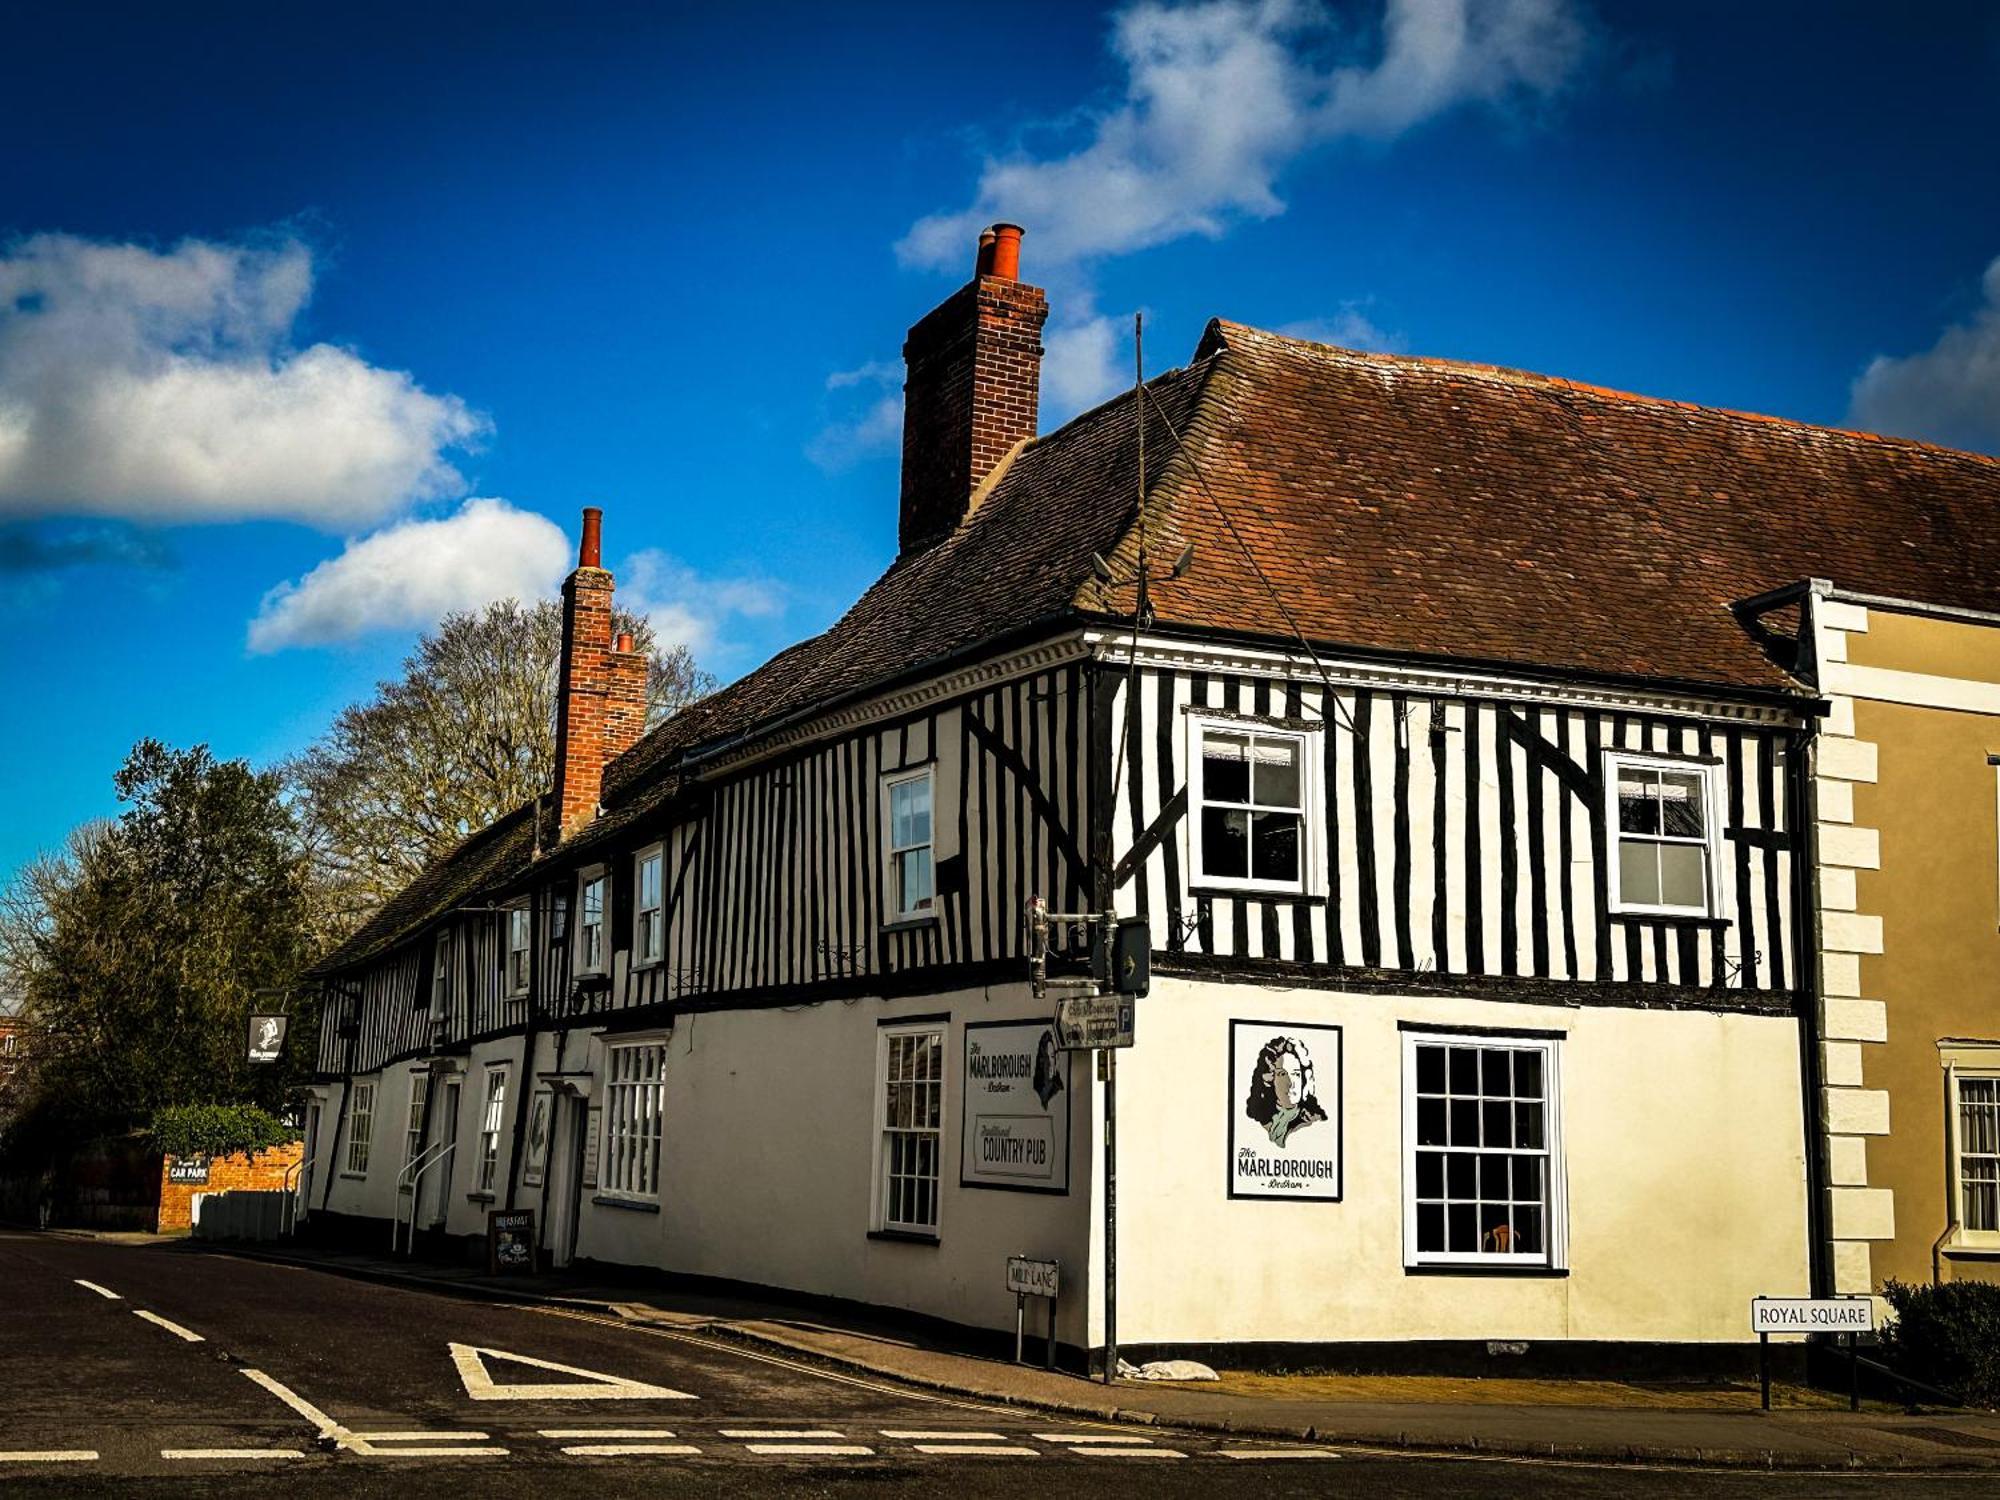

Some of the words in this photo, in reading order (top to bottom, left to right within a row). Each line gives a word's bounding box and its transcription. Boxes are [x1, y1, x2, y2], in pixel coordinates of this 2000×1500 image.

[970, 1054, 1031, 1079] MARLBOROUGH
[983, 1137, 1024, 1163] COUNTRY
[1026, 1138, 1046, 1164] PUB
[1238, 1147, 1257, 1159] The
[170, 1167, 187, 1178] CAR
[187, 1167, 208, 1178] PARK
[1238, 1158, 1333, 1179] MARLBOROUGH
[1268, 1179, 1303, 1190] Dedham
[1760, 1308, 1807, 1323] ROYAL
[1811, 1308, 1866, 1325] SQUARE
